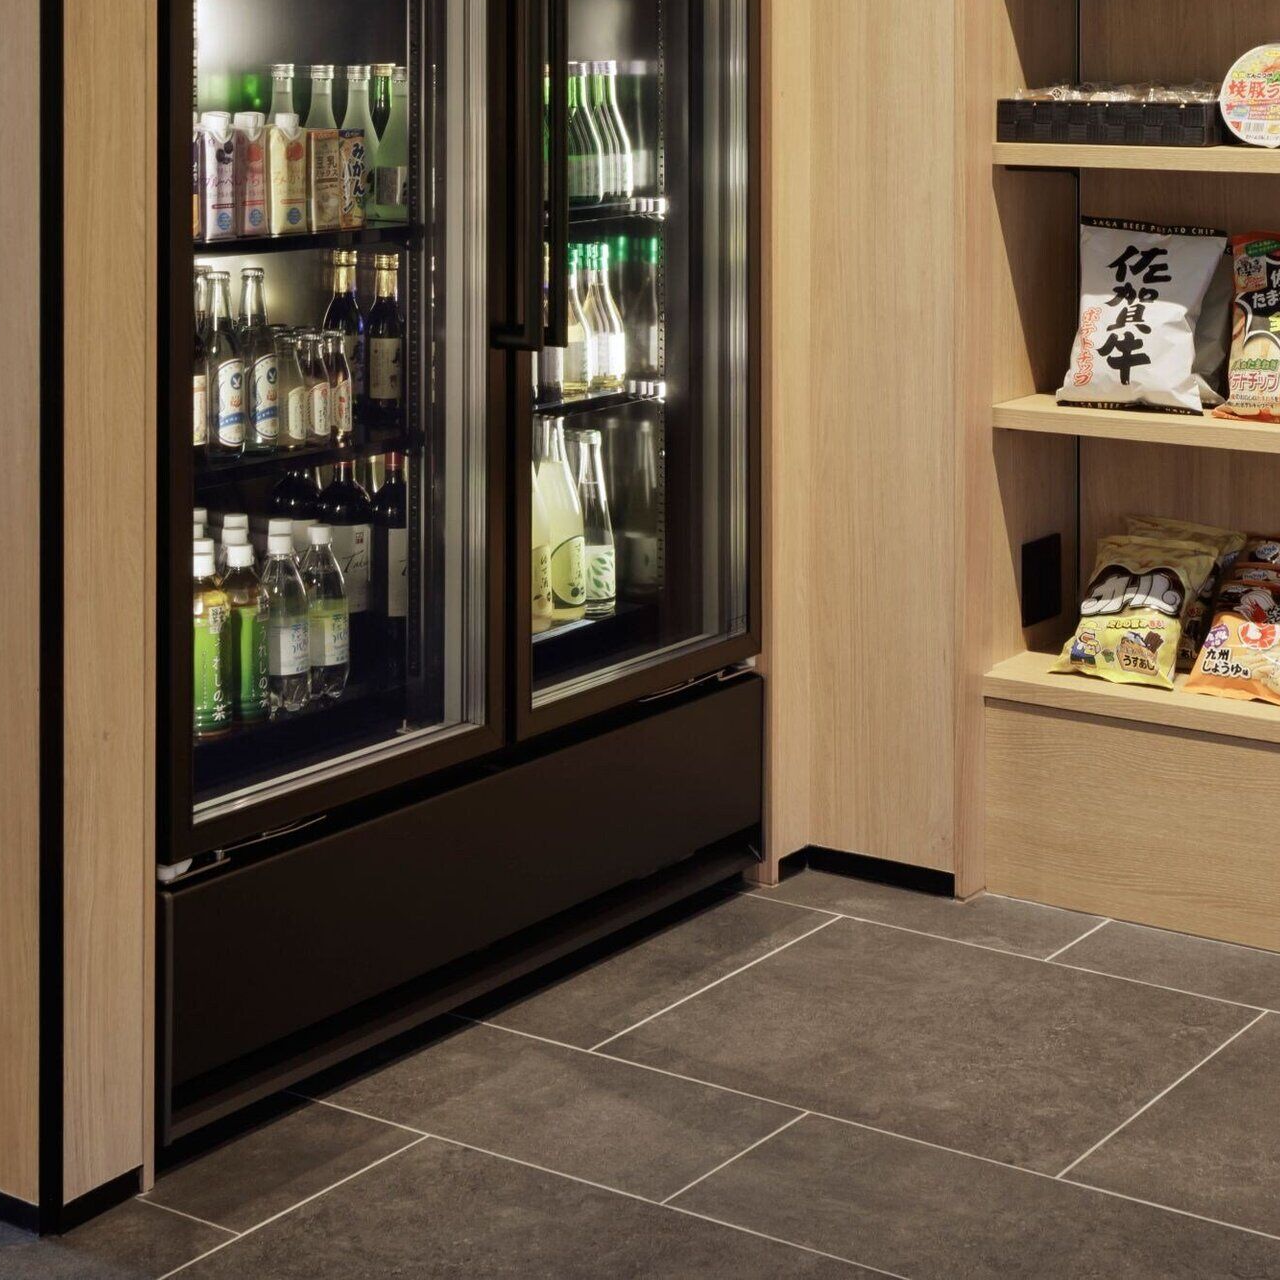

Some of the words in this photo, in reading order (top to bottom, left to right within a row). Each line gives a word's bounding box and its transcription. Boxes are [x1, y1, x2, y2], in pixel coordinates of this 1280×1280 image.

[1096, 245, 1173, 386] 佐賀牛
[1228, 371, 1280, 393] テトチップ
[1080, 572, 1181, 617] カール
[1123, 655, 1156, 671] うすあじ
[1205, 648, 1231, 661] 九州
